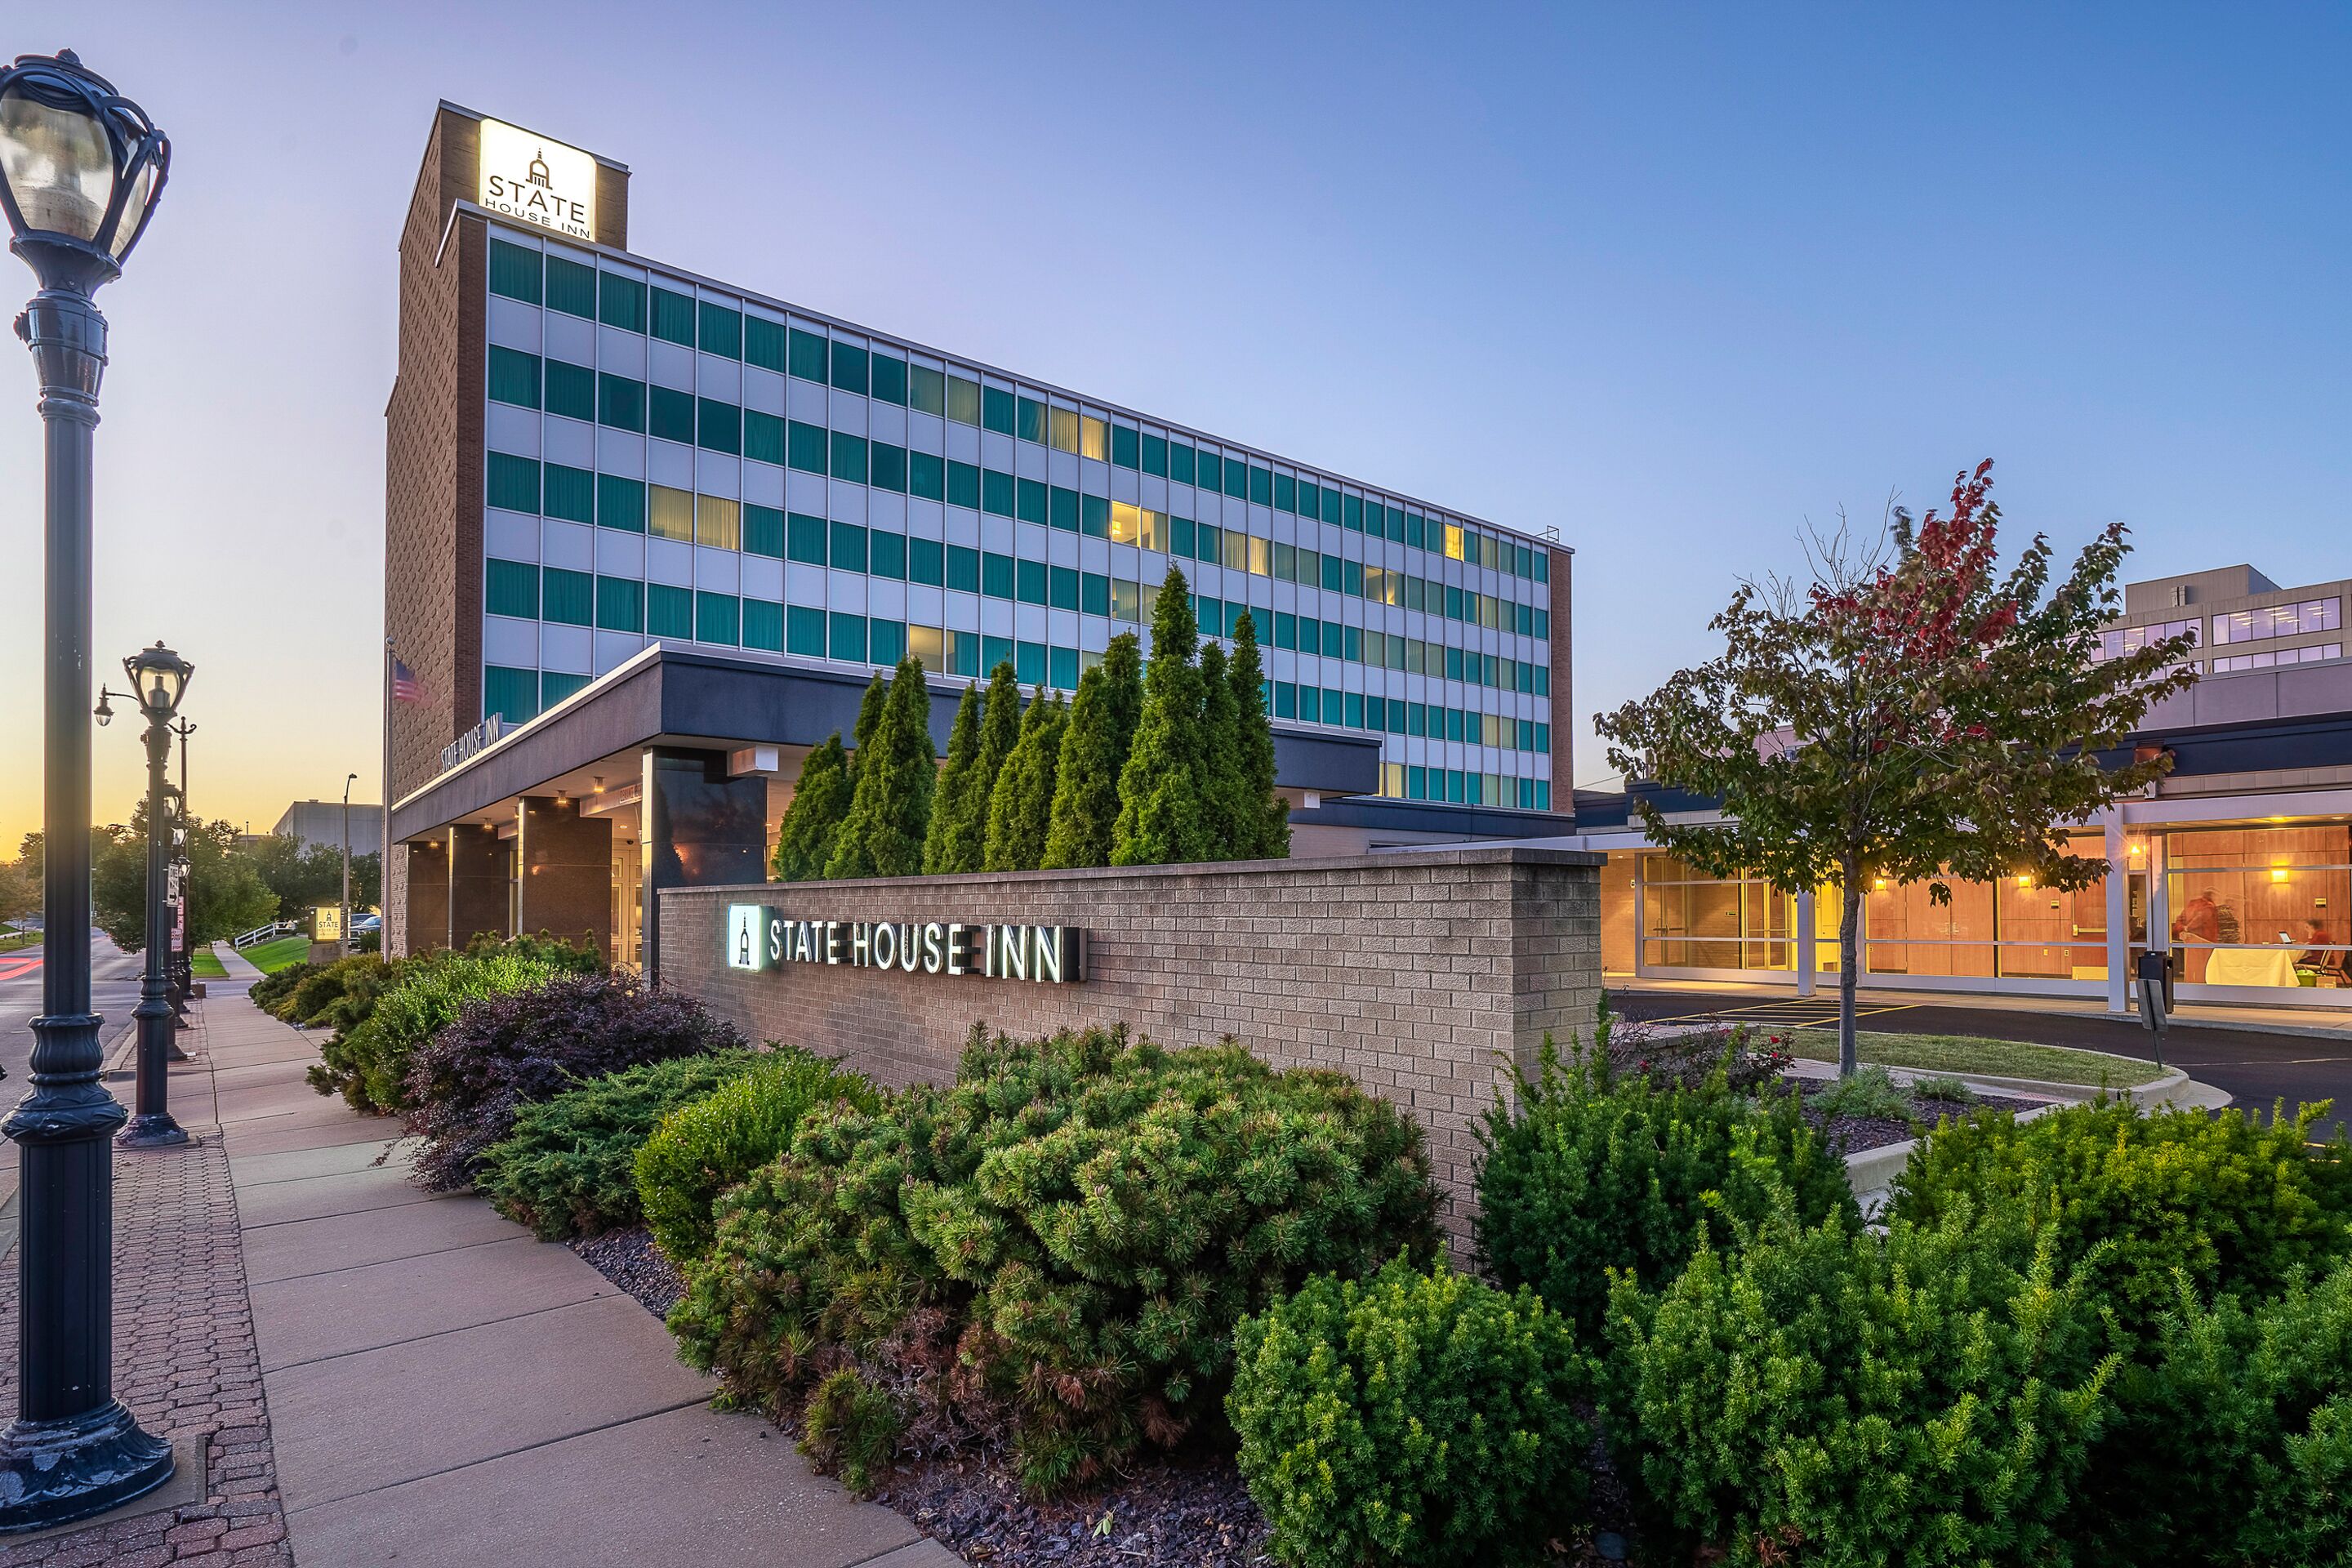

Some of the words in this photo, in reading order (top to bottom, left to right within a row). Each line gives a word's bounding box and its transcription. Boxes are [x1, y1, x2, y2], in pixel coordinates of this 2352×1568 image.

[485, 198, 551, 226] HOUSE
[561, 222, 590, 238] INN
[489, 175, 585, 224] STATE
[441, 740, 457, 773] STATE
[459, 724, 481, 763] HOUSE
[486, 712, 499, 746] INN
[769, 920, 840, 965] STATE
[853, 921, 965, 975] HOUSE
[986, 924, 1064, 983] INN
